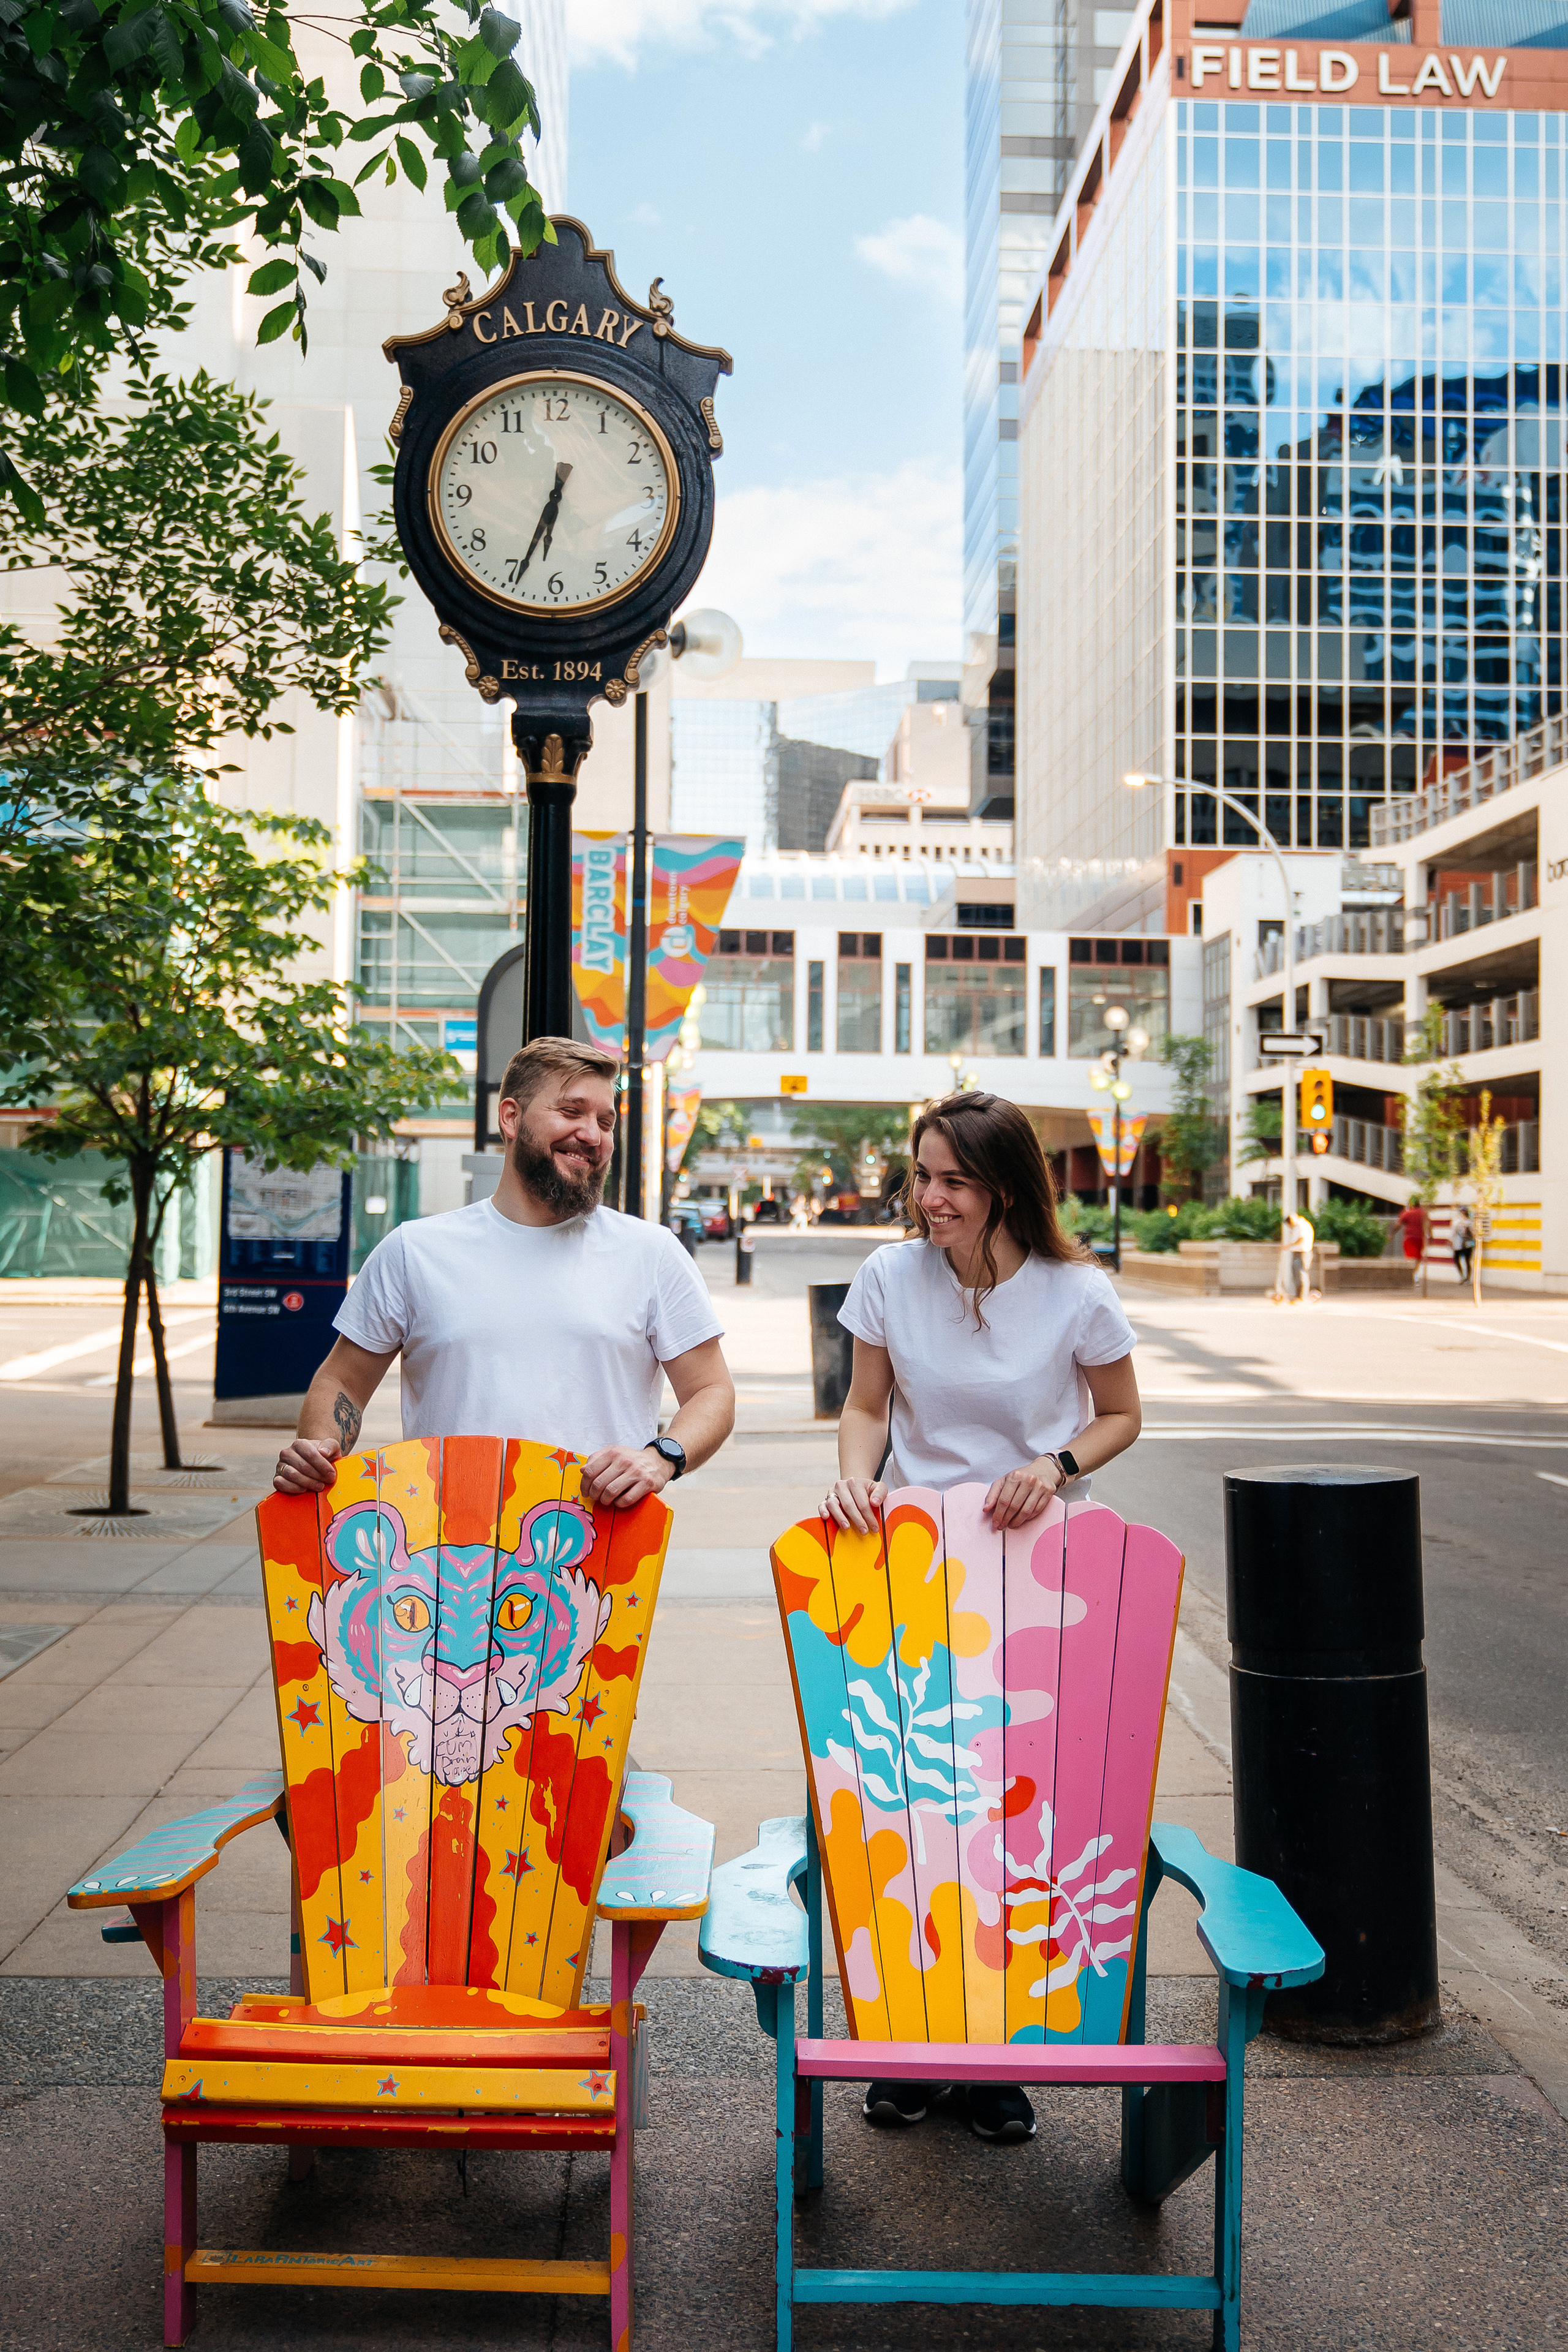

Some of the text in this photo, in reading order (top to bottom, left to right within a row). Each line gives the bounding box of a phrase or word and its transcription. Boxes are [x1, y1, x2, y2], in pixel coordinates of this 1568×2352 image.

[1189, 45, 1507, 97] FIELD LAW
[473, 300, 643, 348] CALGARY
[542, 398, 571, 421] 12
[500, 410, 523, 433] 11
[597, 412, 608, 434] 1
[470, 442, 497, 464] 10
[627, 442, 642, 464] 2
[456, 484, 472, 508] 9
[642, 486, 655, 510] 3
[470, 528, 486, 551] 8
[627, 527, 642, 551] 4
[505, 559, 521, 582] 7
[594, 562, 607, 584] 5
[548, 571, 564, 595] 6
[500, 660, 602, 682] Est. 1894
[585, 850, 612, 971] BARCLAY
[679, 884, 690, 924] calgary
